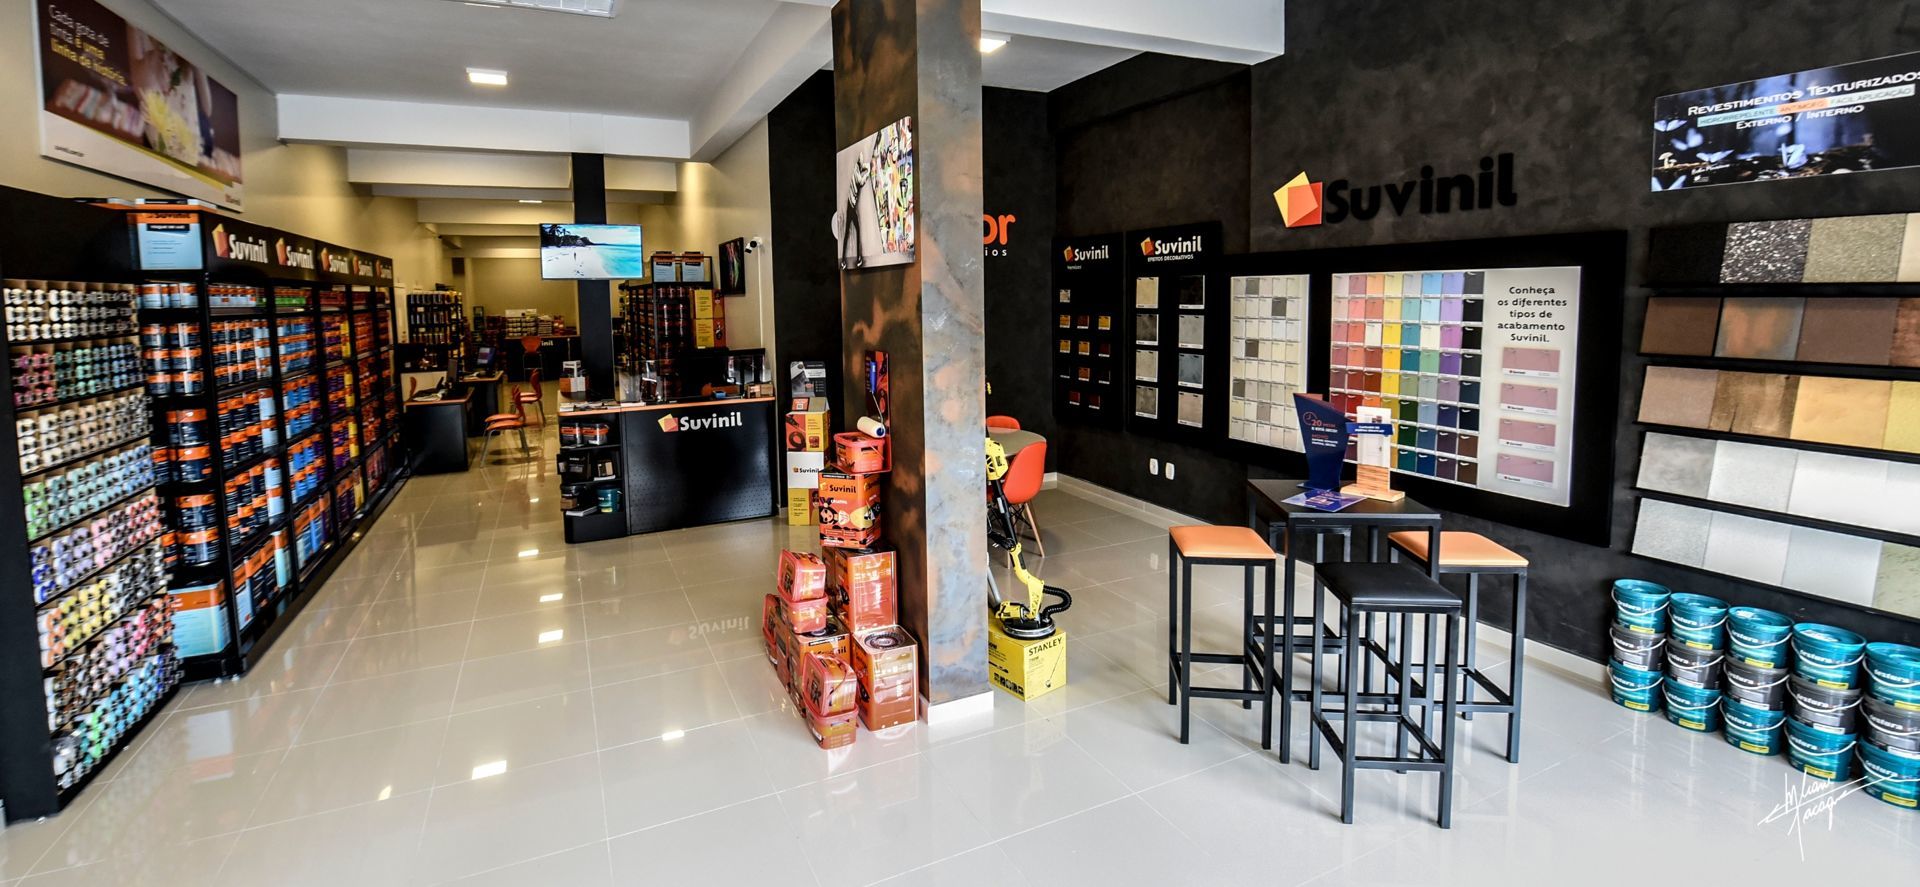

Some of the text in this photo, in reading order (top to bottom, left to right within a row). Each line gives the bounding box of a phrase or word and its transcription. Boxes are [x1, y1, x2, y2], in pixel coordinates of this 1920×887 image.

[1325, 153, 1518, 225] Suvinil
[229, 234, 269, 264] Suvinil
[1074, 245, 1110, 262] Suvinil
[1155, 235, 1203, 256] Suvinil
[286, 246, 315, 270] Suvinil
[328, 254, 350, 275] Suvinil
[1508, 286, 1555, 296] Conheça
[1511, 298, 1568, 308] diferentes
[1509, 310, 1553, 319] tipos de
[1497, 322, 1566, 331] acabamento
[1510, 333, 1550, 343] Suvinil.
[680, 411, 743, 432] Suvinil
[829, 484, 857, 494] Suvinil
[1028, 637, 1063, 657] STANLEY
